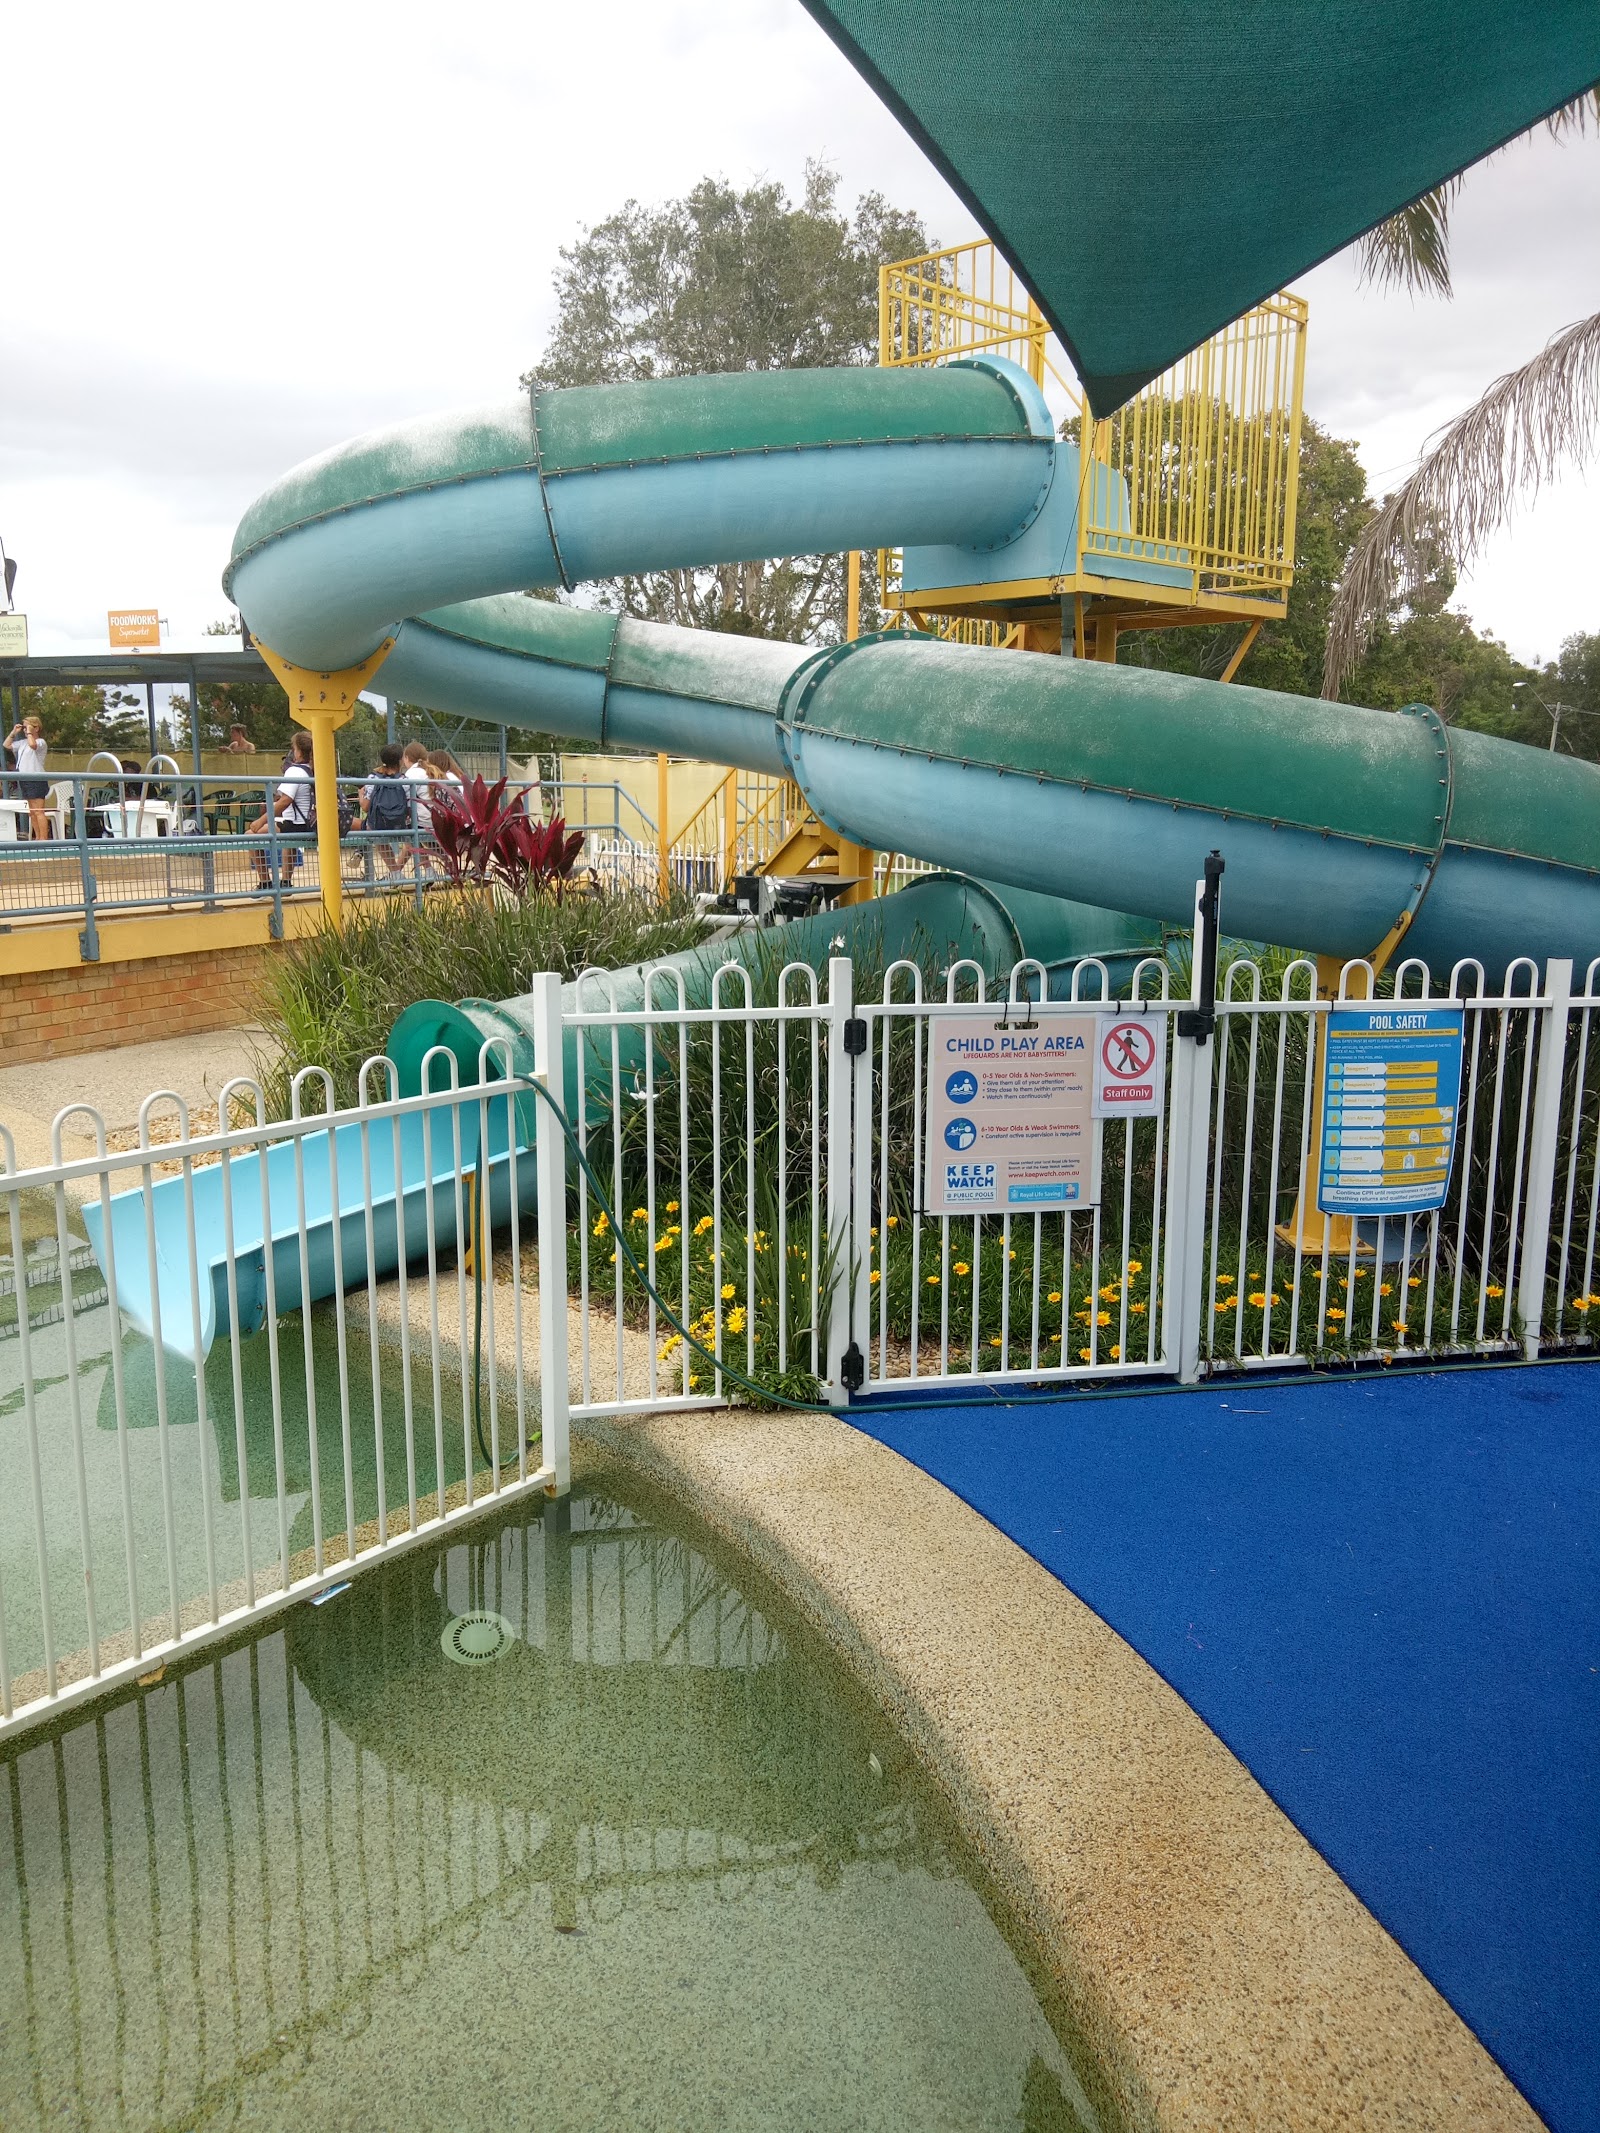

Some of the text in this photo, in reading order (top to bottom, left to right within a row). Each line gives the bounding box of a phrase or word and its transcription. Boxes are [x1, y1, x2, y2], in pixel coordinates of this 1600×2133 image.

[110, 614, 156, 626] FOODWORKS
[118, 626, 150, 640] Supermarket
[1369, 1015, 1427, 1029] POOL SAFETY
[946, 1036, 1085, 1052] CHILD PLAY AREA
[1106, 1089, 1150, 1098] Staff Only
[947, 1165, 994, 1176] KEEP
[948, 1177, 994, 1188] WATCH
